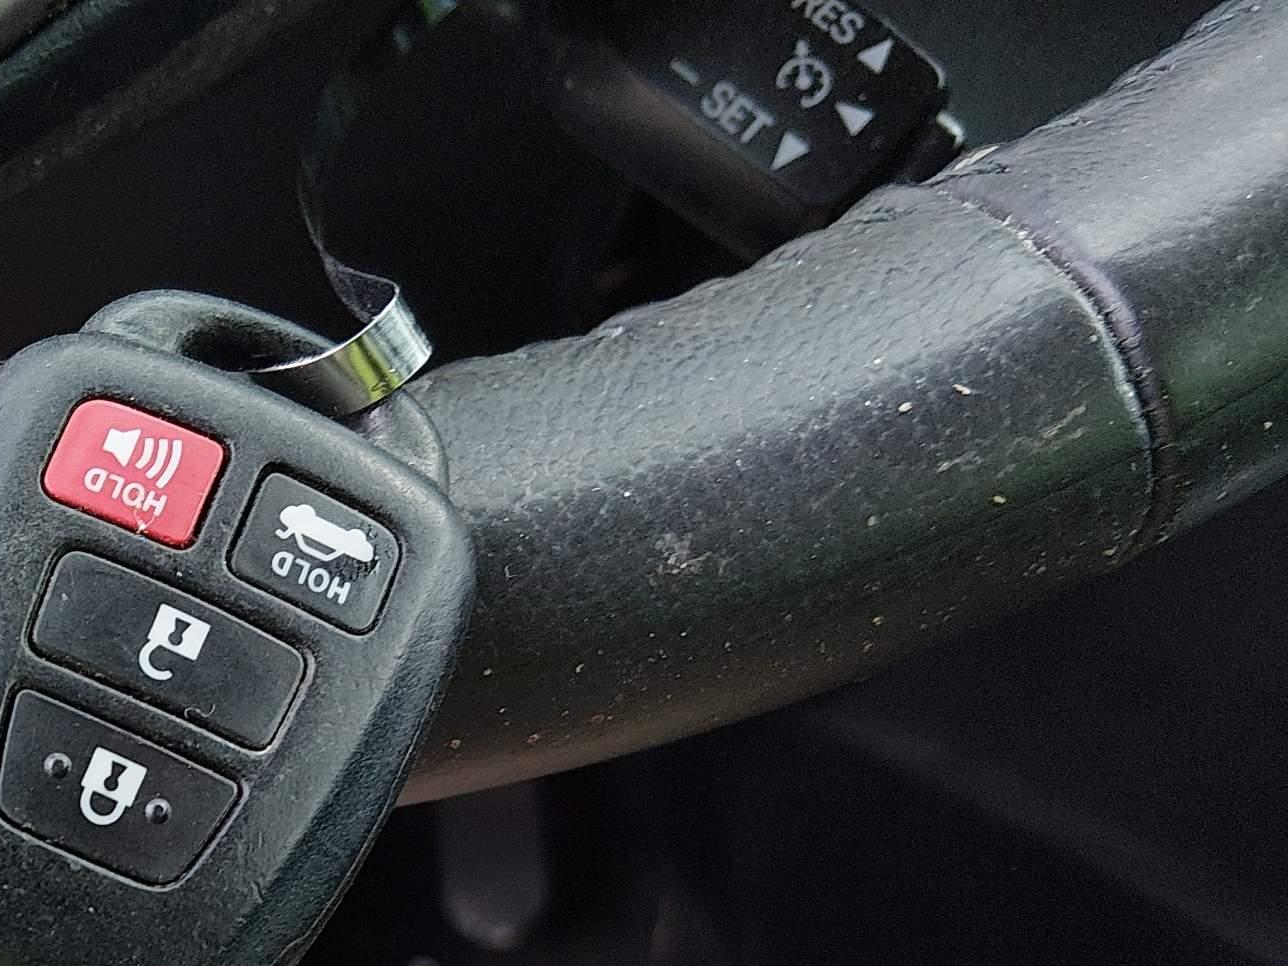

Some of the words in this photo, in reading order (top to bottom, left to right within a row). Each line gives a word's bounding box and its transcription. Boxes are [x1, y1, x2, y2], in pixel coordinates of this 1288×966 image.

[701, 80, 775, 144] SET
[83, 467, 167, 516] HOLD
[271, 550, 351, 605] HOLD
